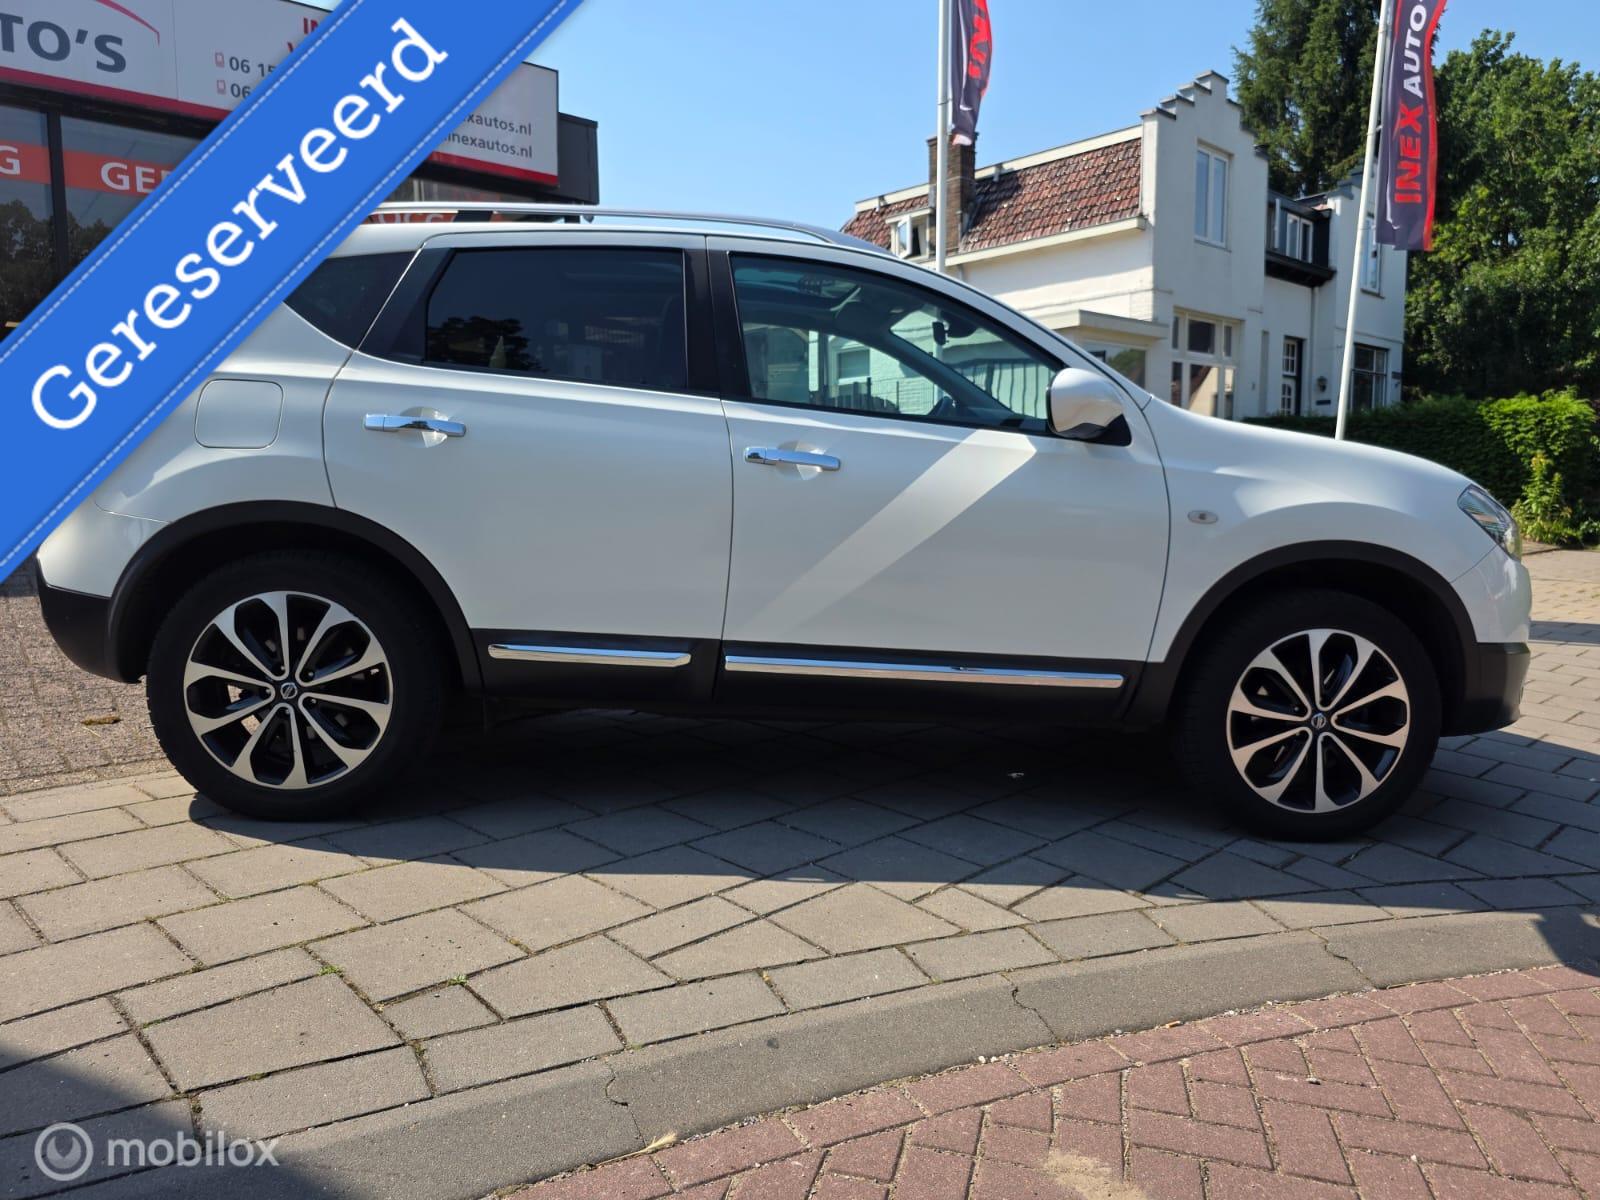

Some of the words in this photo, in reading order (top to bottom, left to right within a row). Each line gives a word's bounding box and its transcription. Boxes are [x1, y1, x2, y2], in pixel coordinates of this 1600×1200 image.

[1403, 0, 1427, 98] AUTO
[229, 56, 251, 74] 06
[230, 83, 252, 99] 06
[463, 113, 532, 137] xautos.nl
[1393, 103, 1424, 204] INEX
